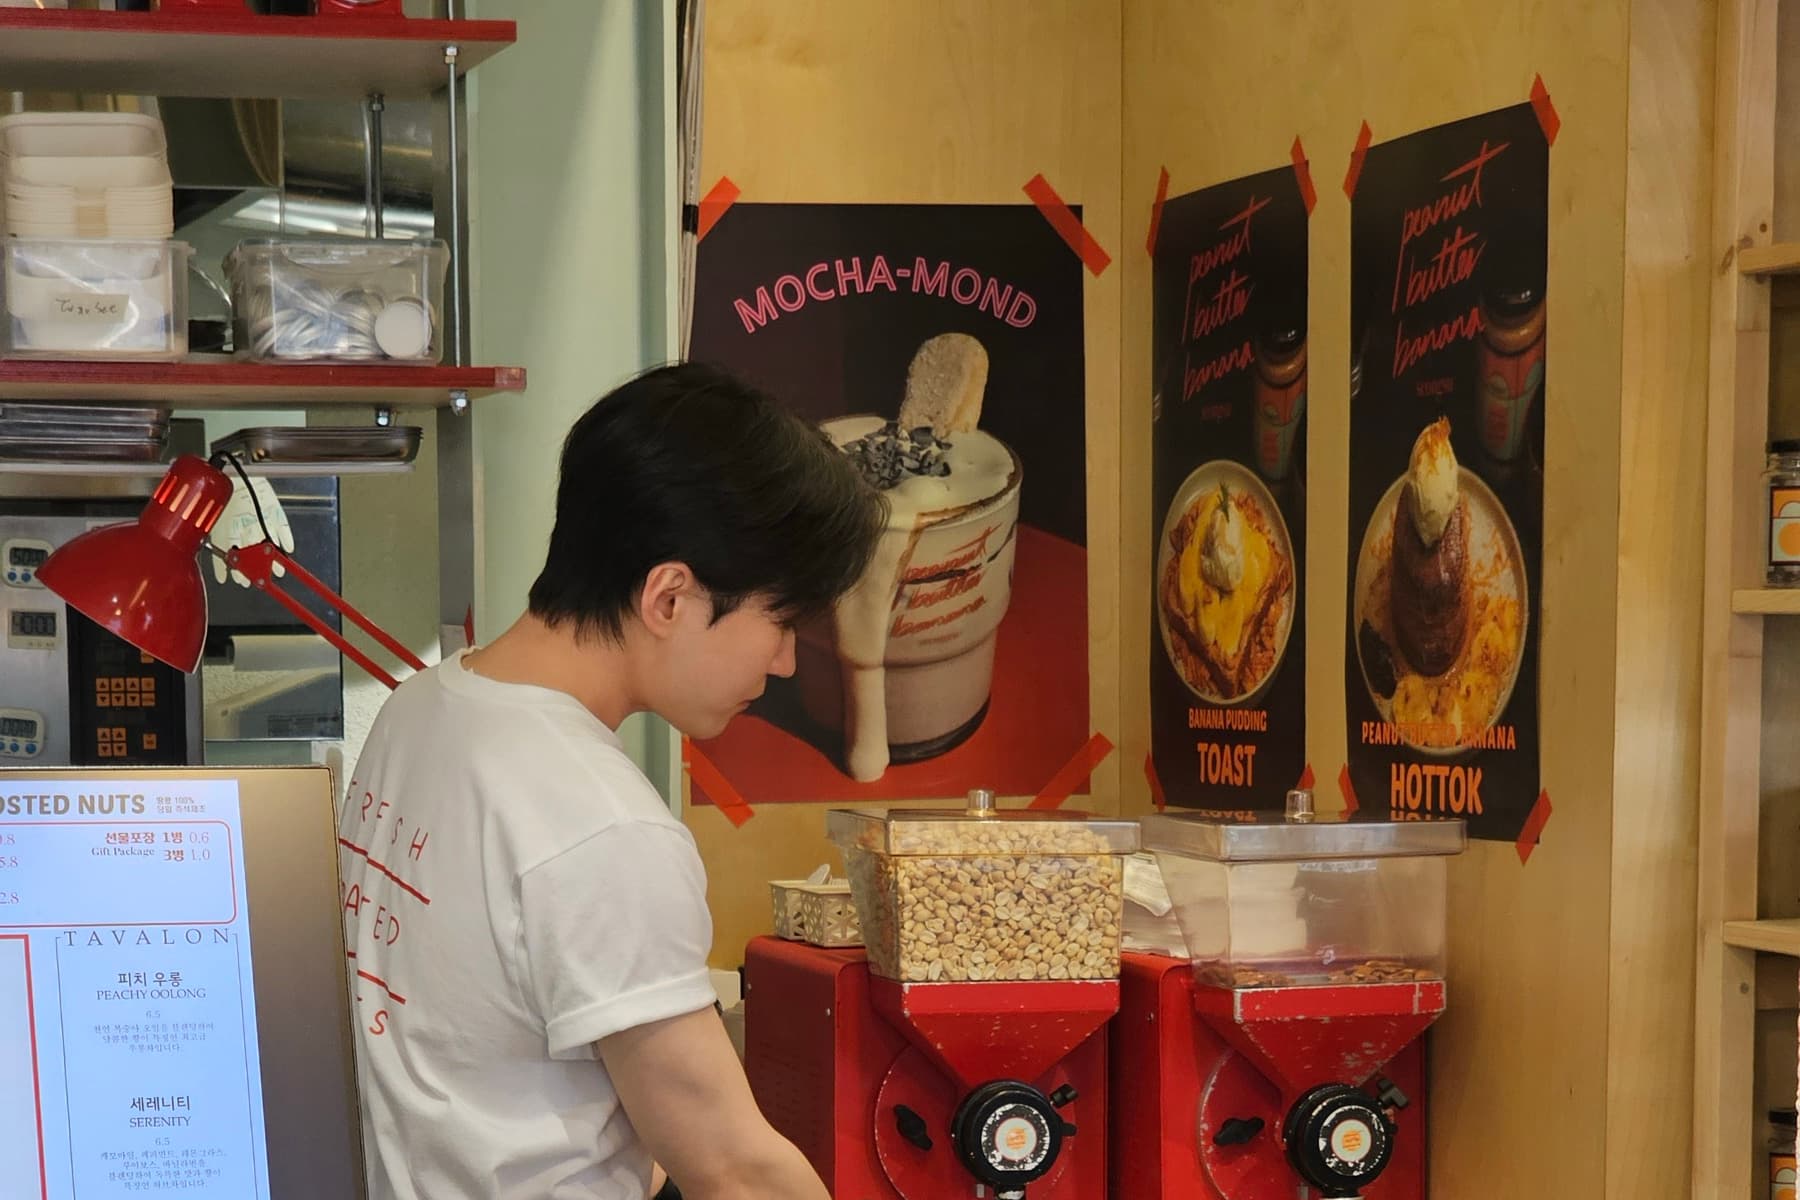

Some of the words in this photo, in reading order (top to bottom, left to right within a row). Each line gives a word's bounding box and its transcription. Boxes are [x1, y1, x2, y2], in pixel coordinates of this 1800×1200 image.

[1392, 139, 1511, 314] peanut
[1181, 194, 1273, 344] peanut
[1406, 225, 1487, 306] butter
[734, 256, 1037, 333] MOCHA-MOND
[1193, 269, 1256, 340] butter
[1393, 307, 1485, 379] banana
[1183, 340, 1255, 402] banana
[1188, 708, 1224, 728] BANANA
[1225, 710, 1267, 732] PUDDING
[1362, 721, 1405, 746] PEANUT
[1461, 725, 1516, 750] BANANA
[1198, 742, 1256, 787] TOAST
[1391, 763, 1482, 815] HOTTOK
[78, 794, 145, 815] NUTS
[349, 781, 428, 861] RESH
[105, 832, 155, 845] 선물포장
[163, 831, 184, 844] 1병
[189, 832, 209, 844] 0.6
[92, 847, 110, 856] Gift
[114, 847, 155, 857] Package
[165, 849, 184, 862] 3병
[191, 849, 210, 861] 1.0
[63, 928, 230, 947] TAVALON
[118, 972, 147, 987] 피치
[153, 972, 183, 987] 우롱
[97, 989, 148, 1000] PEACHY
[150, 988, 206, 999] OOLONG
[130, 1096, 190, 1112] 세레니티
[130, 1116, 191, 1128] SERENITY
[155, 1138, 170, 1146] 6.5
